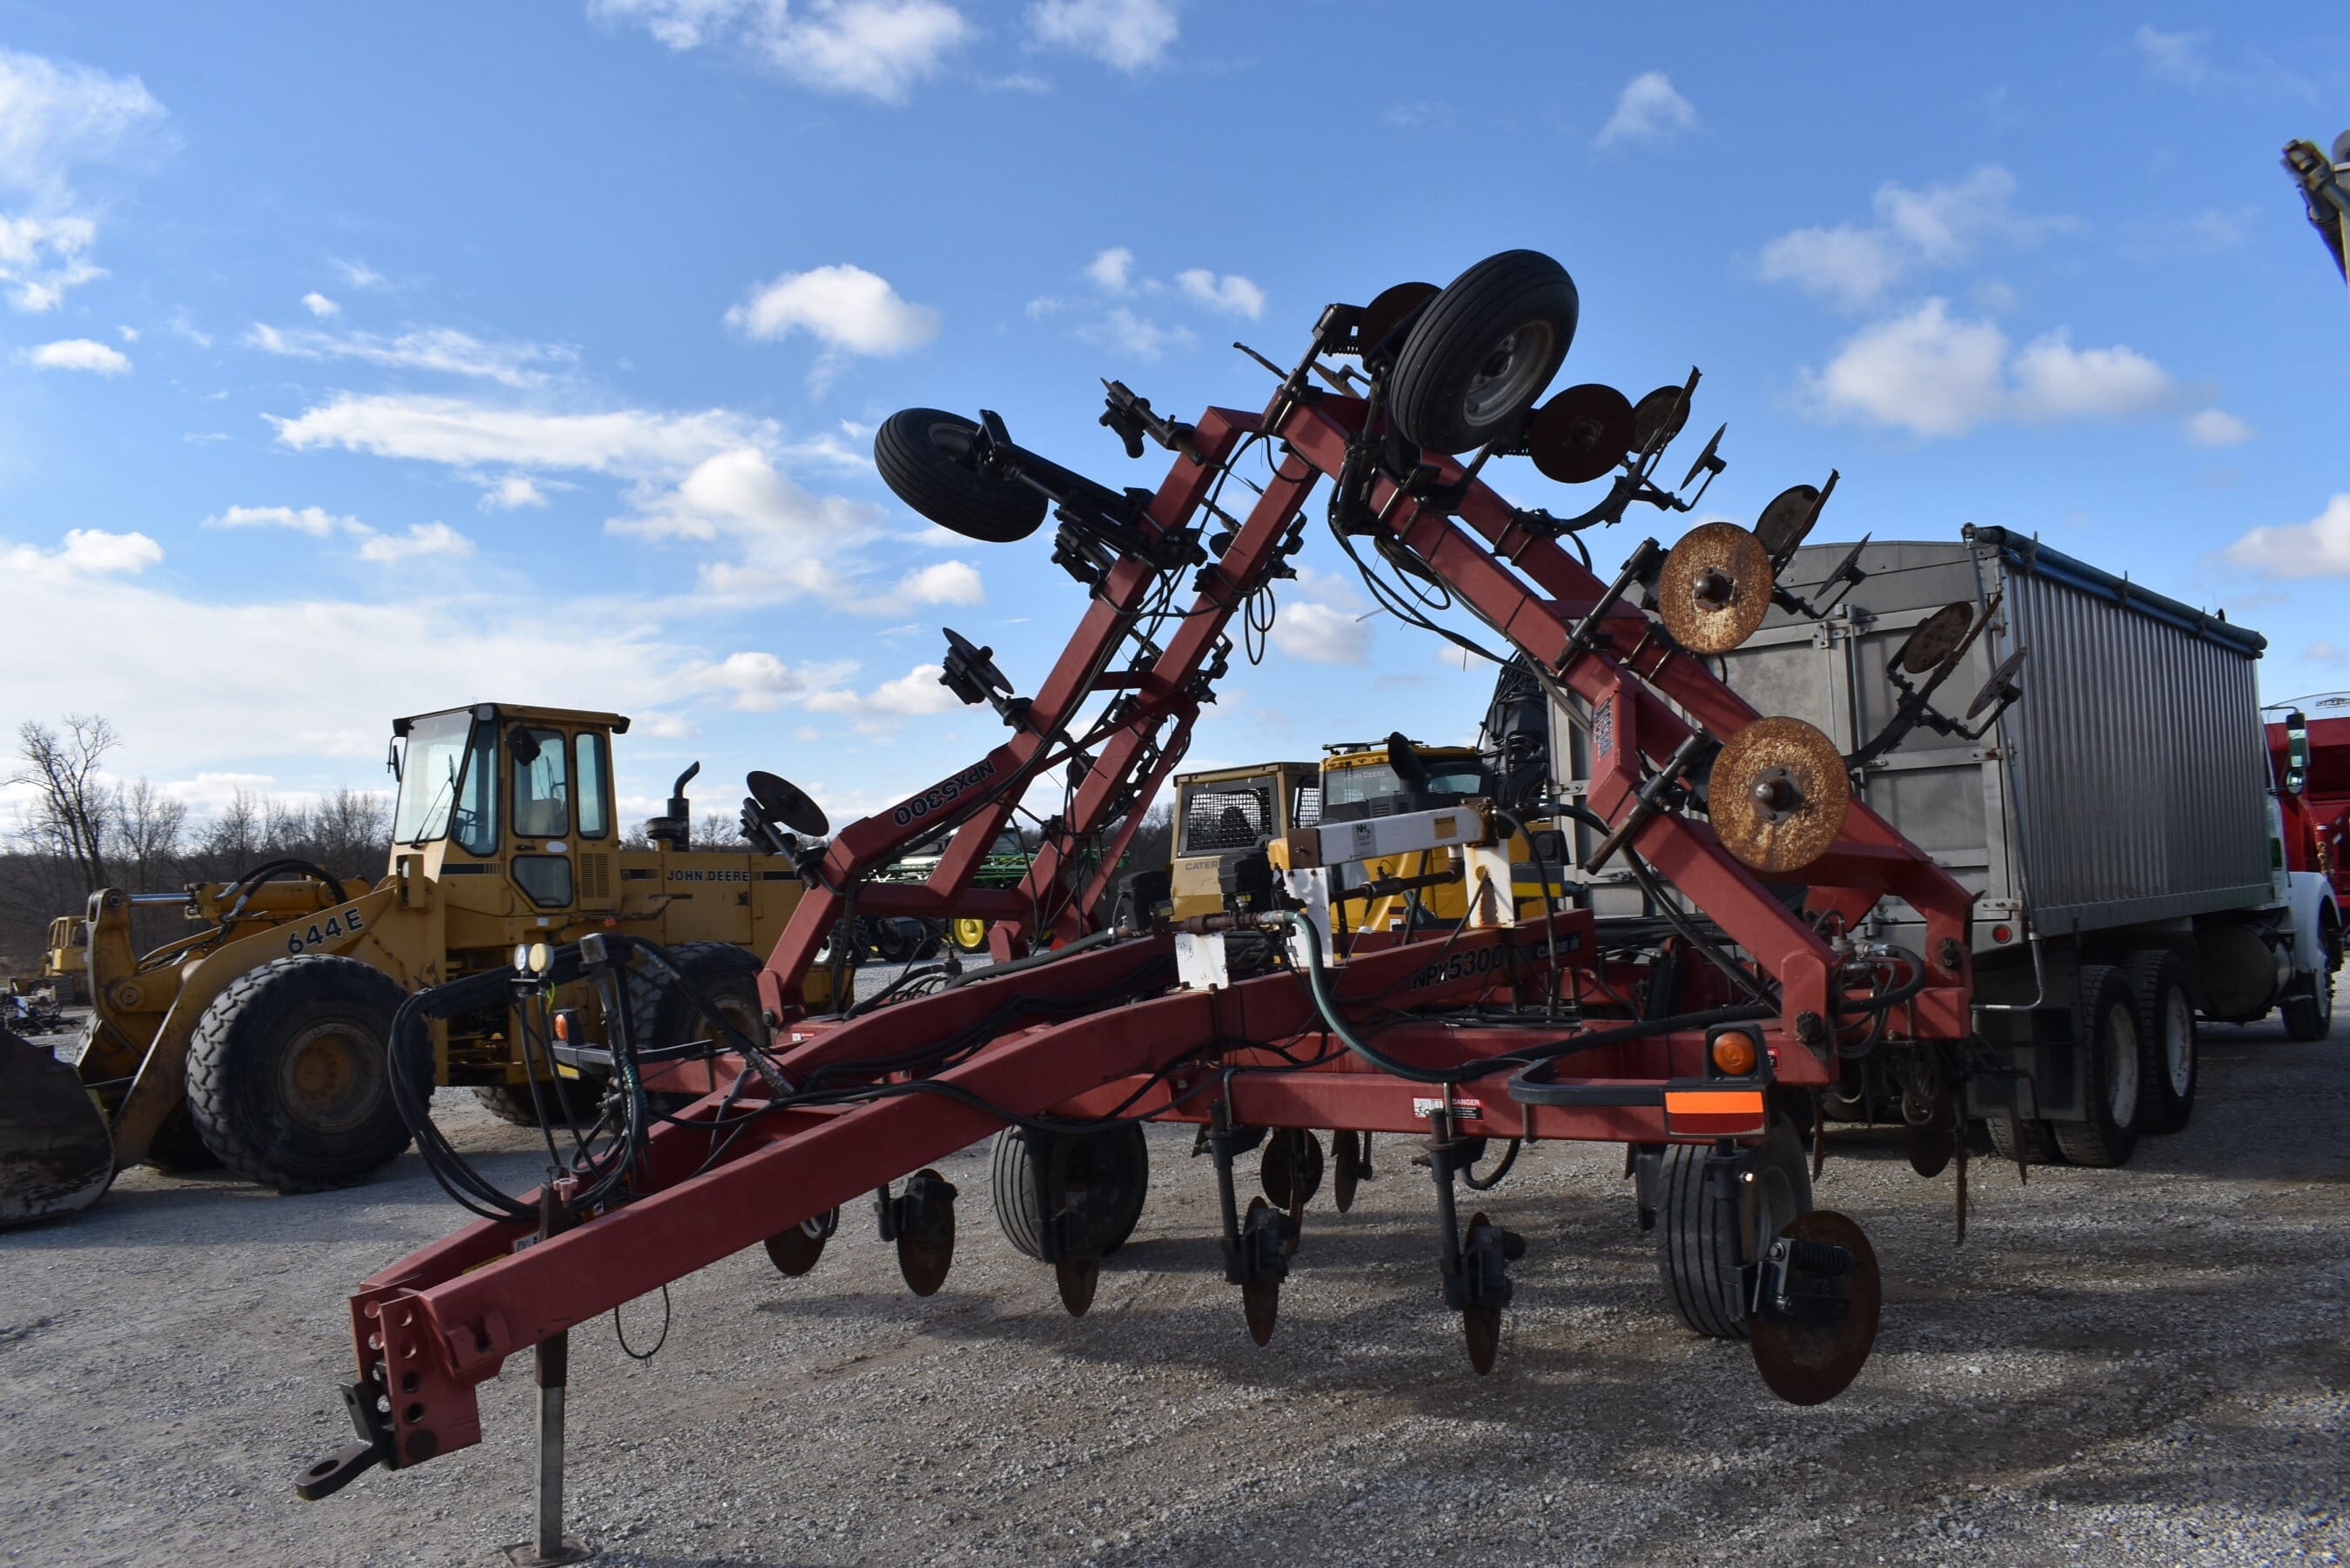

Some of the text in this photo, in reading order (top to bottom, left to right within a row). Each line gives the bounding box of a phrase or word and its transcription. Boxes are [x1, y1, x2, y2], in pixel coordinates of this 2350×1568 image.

[892, 759, 996, 827] NPX5300
[667, 870, 749, 881] JOHN DEERE
[1185, 861, 1219, 870] CATER
[1413, 943, 1505, 990] NPX5300
